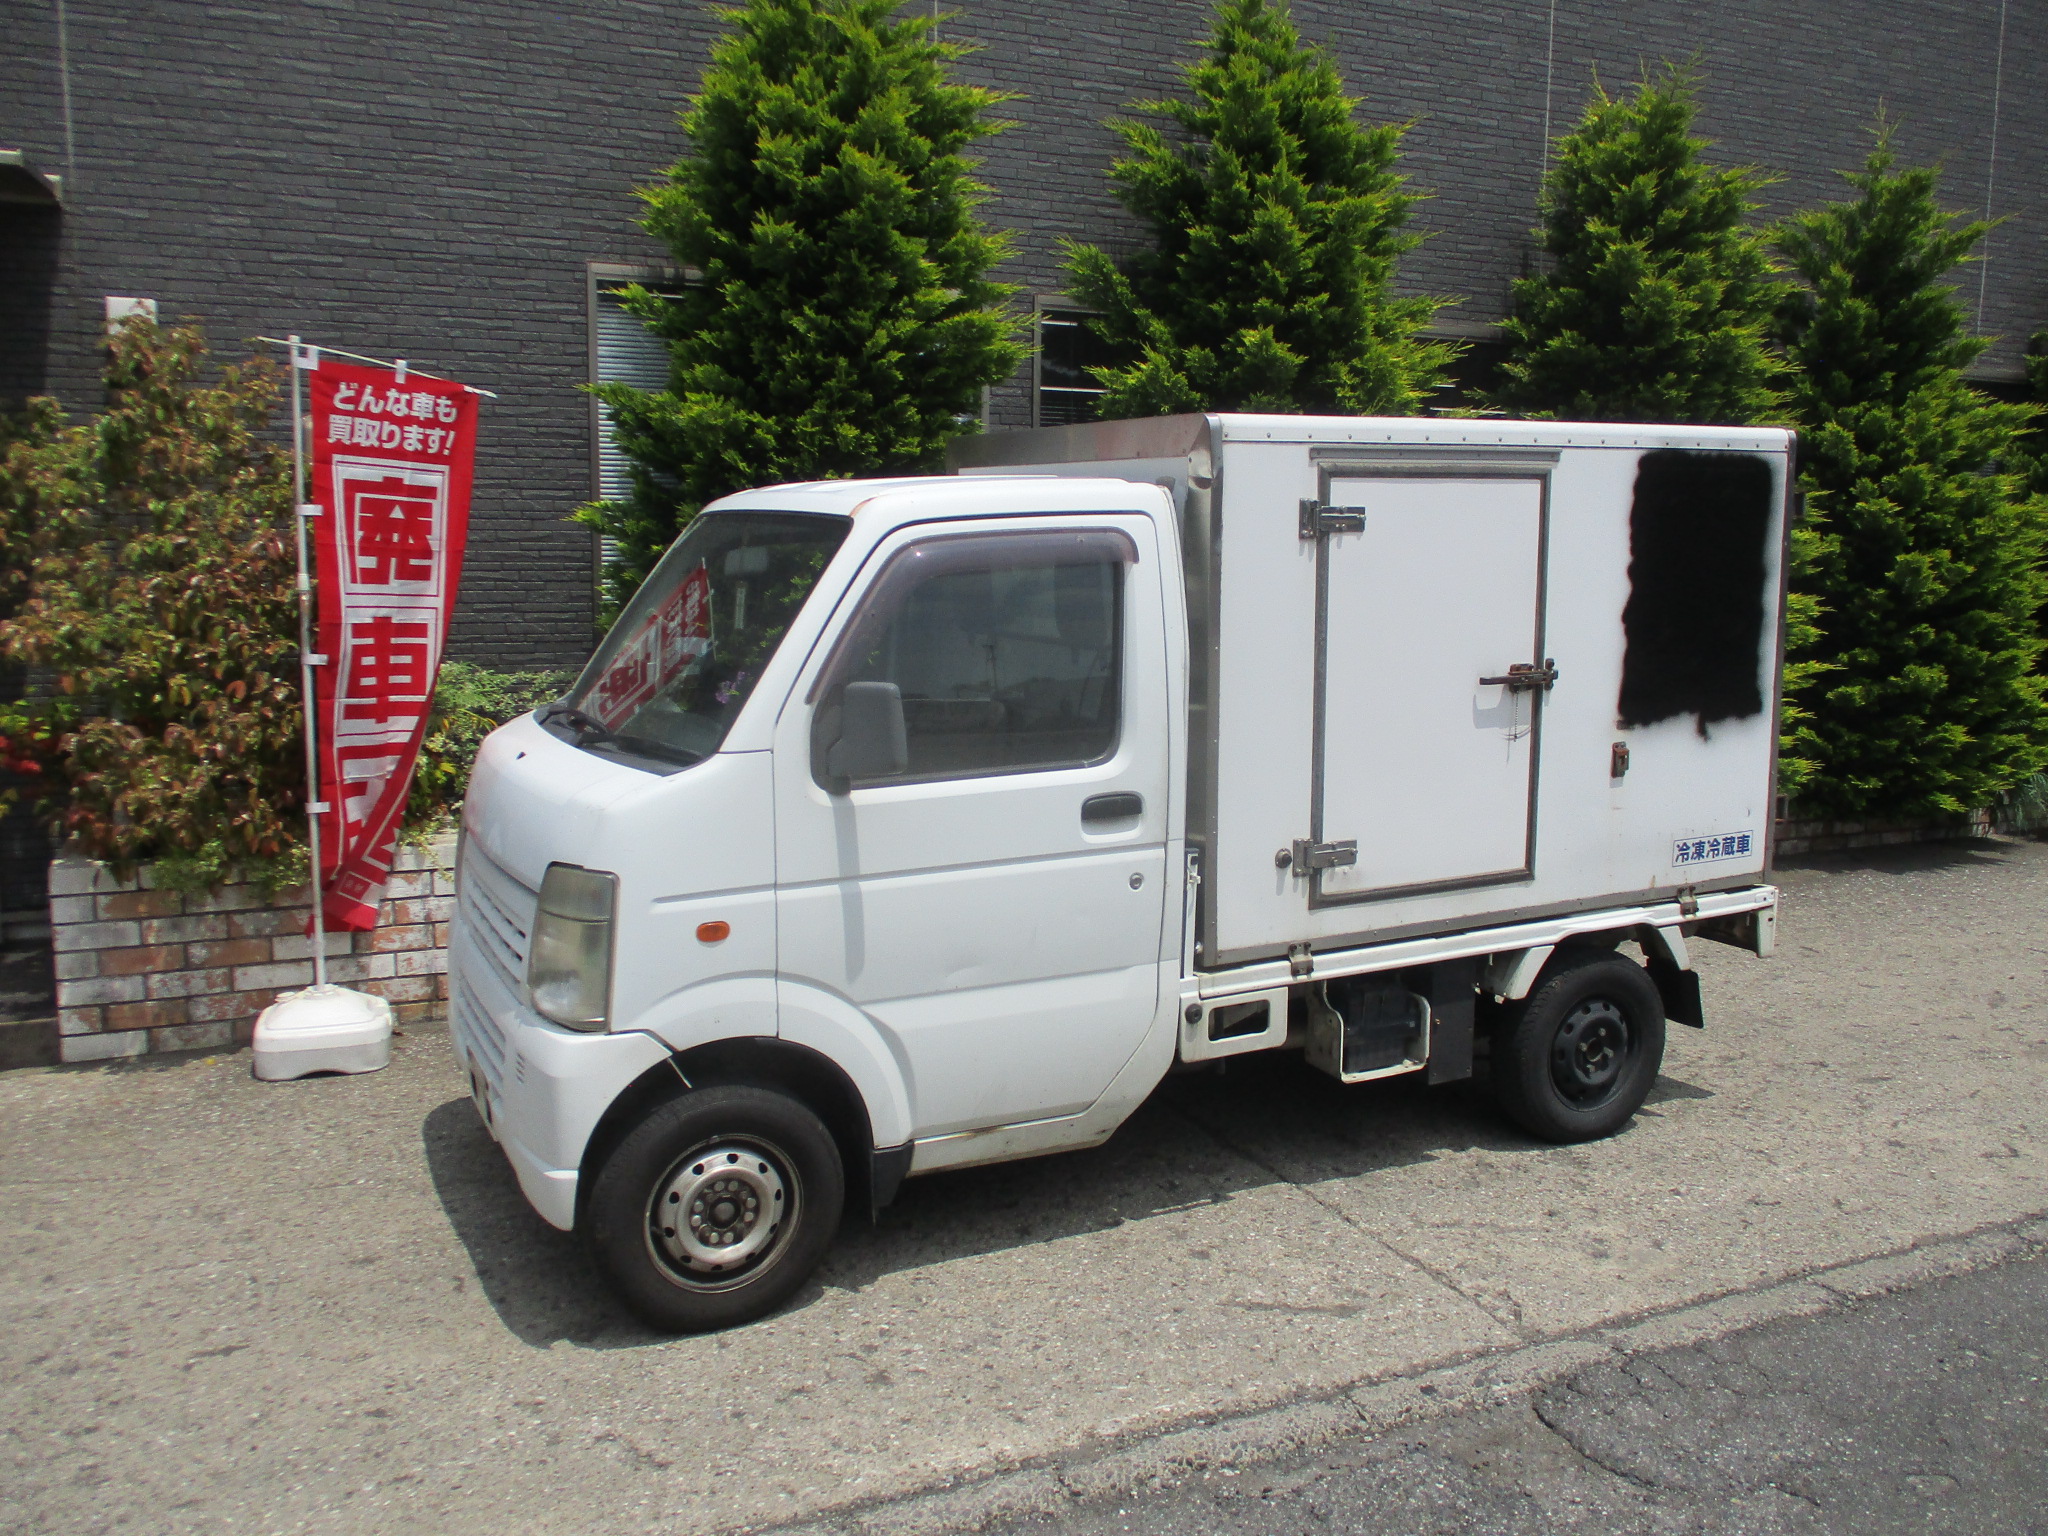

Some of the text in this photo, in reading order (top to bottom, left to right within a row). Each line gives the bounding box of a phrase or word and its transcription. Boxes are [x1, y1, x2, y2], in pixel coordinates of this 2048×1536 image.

[333, 381, 457, 423] どんな車も
[1675, 834, 1751, 863] 冷凍冷蔵車
